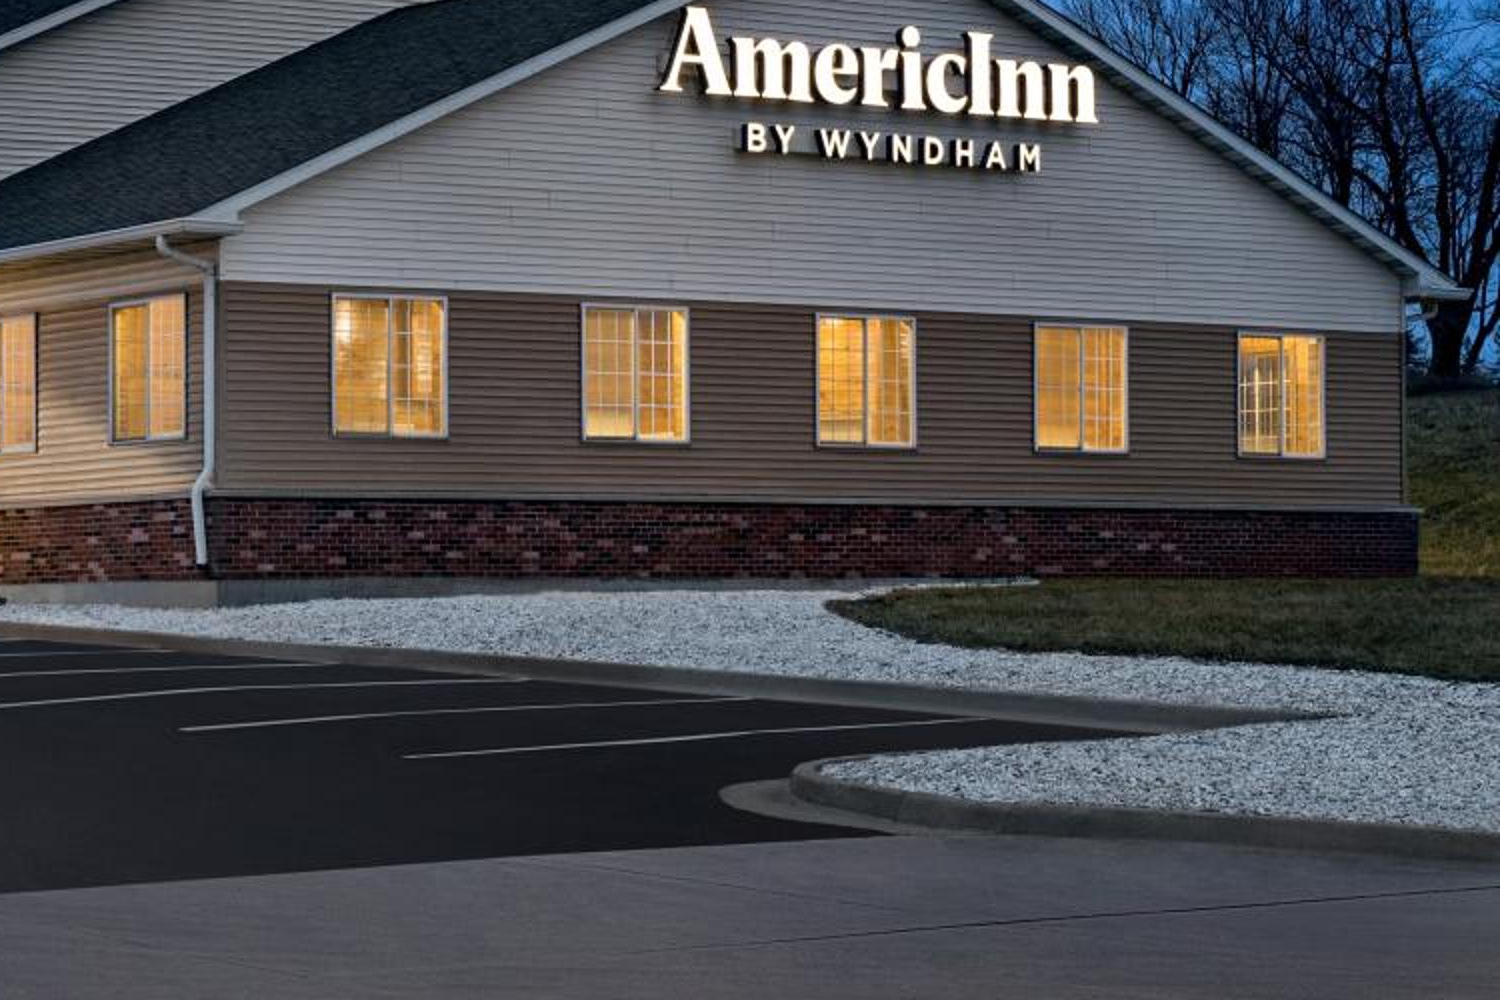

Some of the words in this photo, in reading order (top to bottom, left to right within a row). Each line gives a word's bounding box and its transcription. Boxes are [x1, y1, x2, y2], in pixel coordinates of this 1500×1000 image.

[659, 6, 1099, 124] AmericInn
[746, 123, 795, 153] BY
[820, 128, 1041, 172] WYNDHAM
